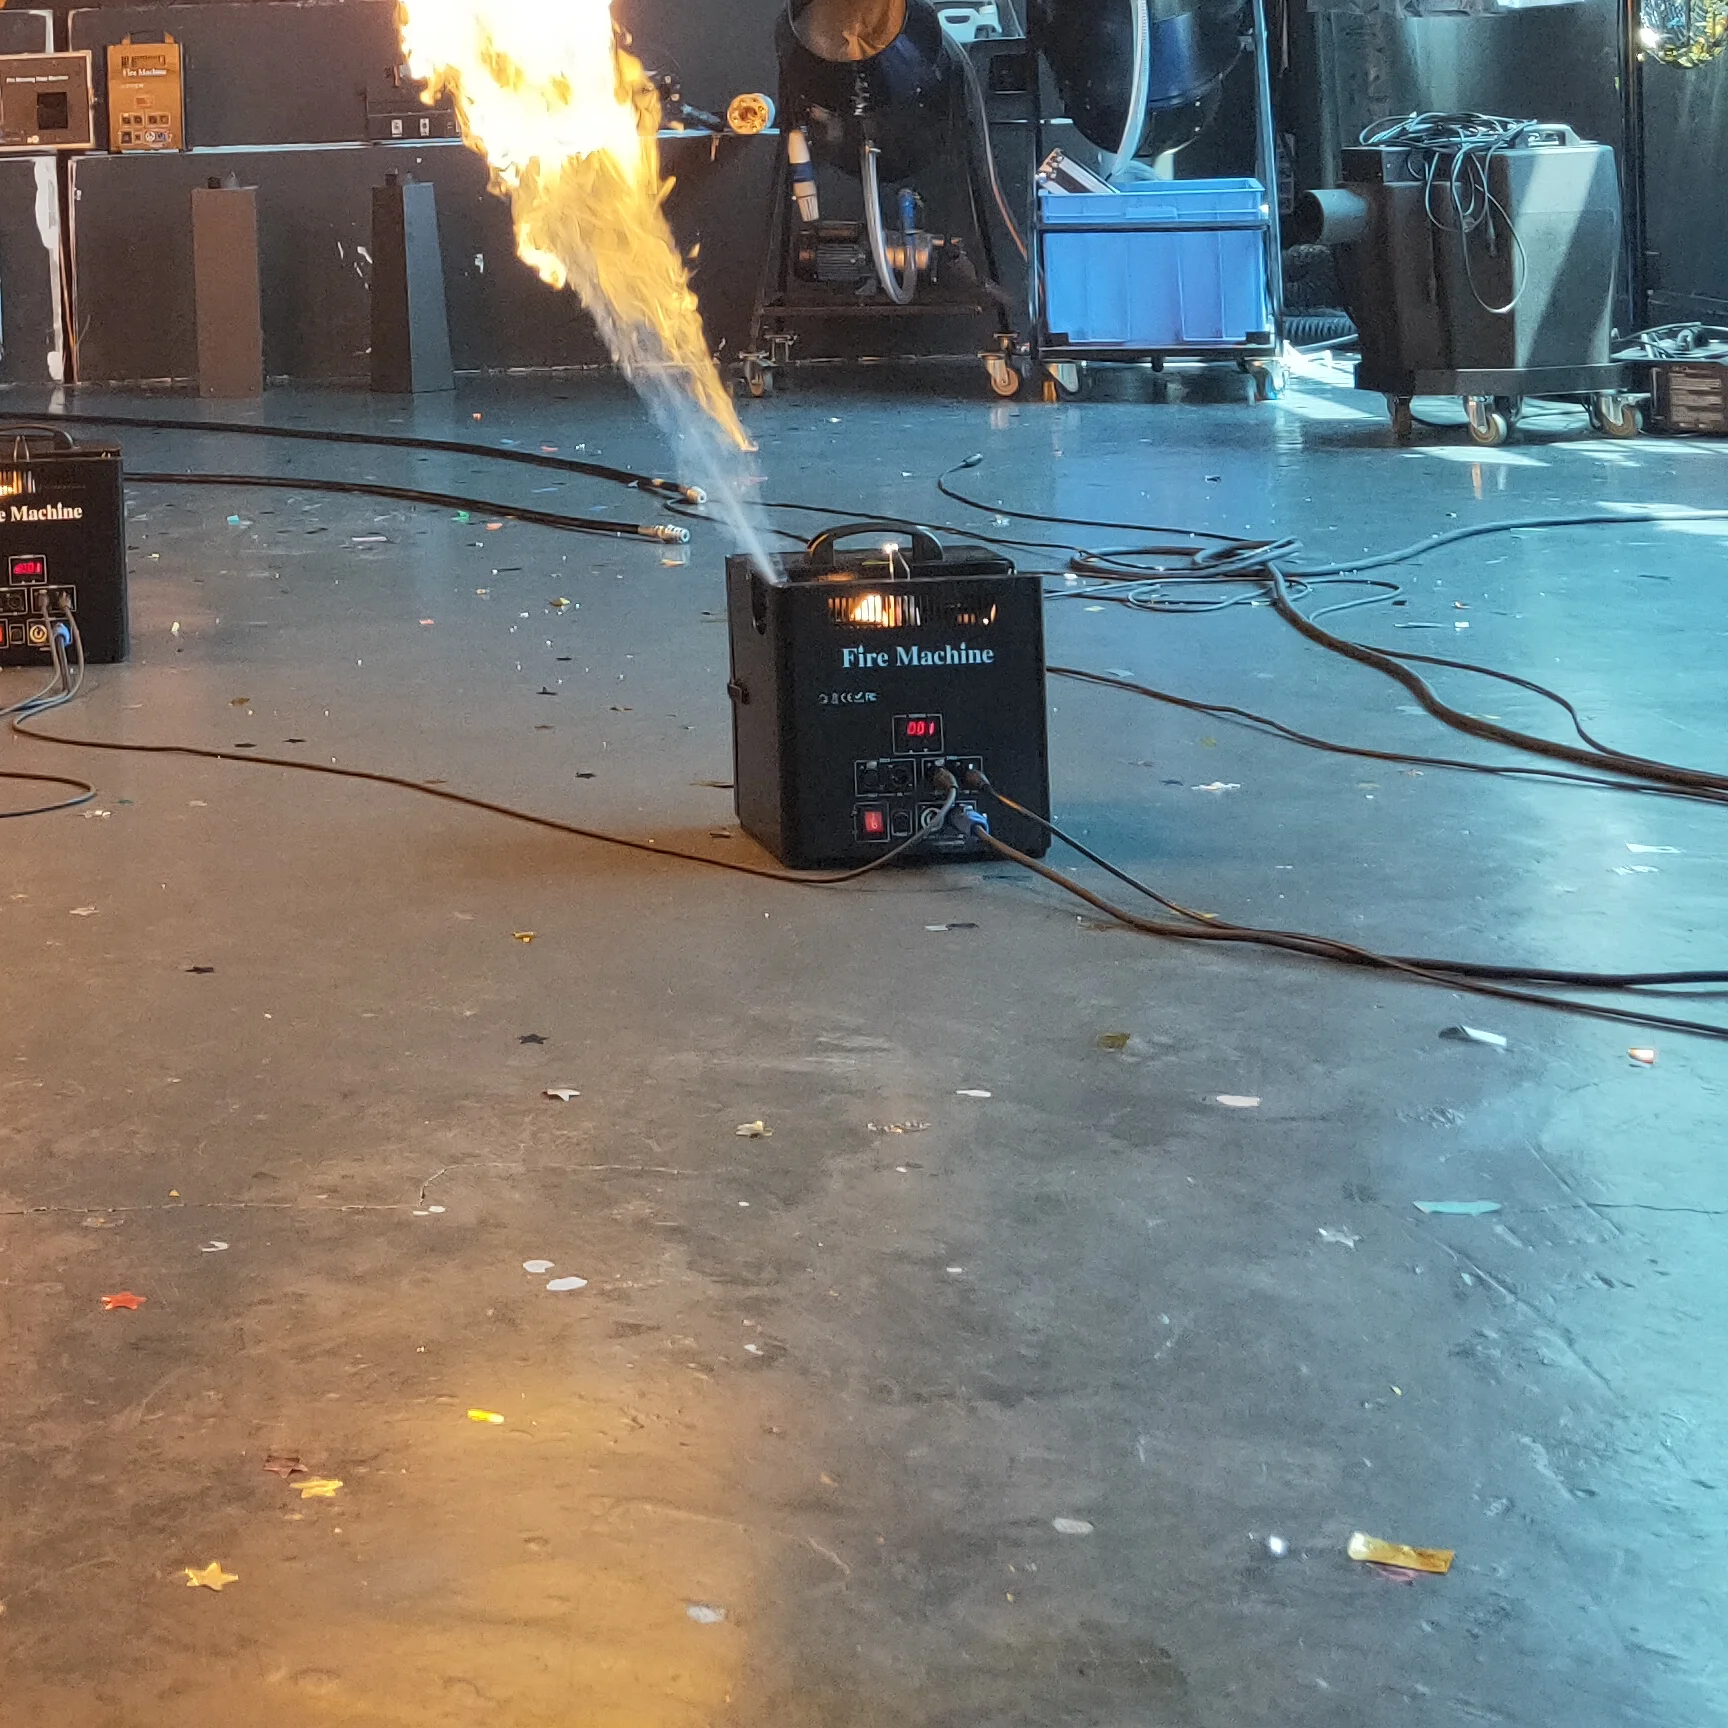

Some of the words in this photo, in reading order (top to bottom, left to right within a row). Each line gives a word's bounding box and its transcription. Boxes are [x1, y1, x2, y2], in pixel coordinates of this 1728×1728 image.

[10, 501, 83, 522] Machine
[842, 644, 889, 668] Fire
[895, 641, 995, 667] Machine
